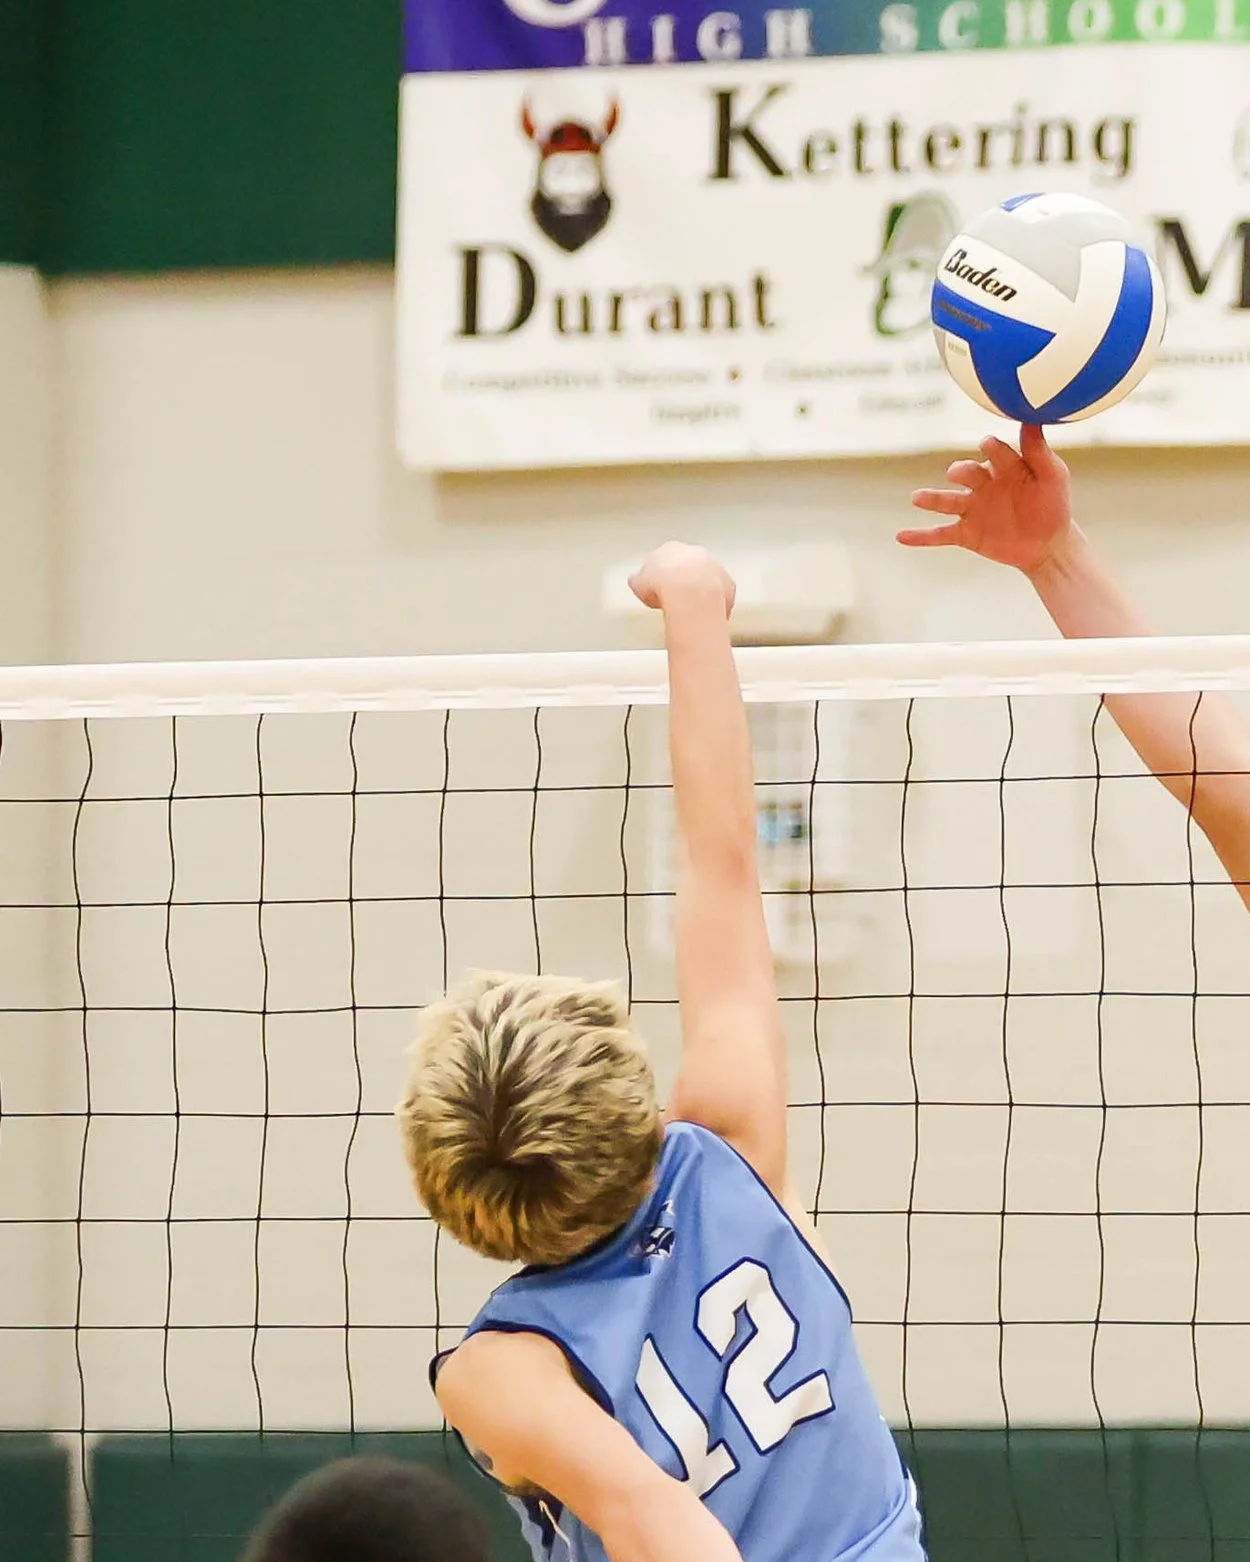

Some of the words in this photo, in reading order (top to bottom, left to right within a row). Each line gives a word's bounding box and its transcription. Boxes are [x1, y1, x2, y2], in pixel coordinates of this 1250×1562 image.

[581, 8, 813, 65] HIGH
[706, 83, 1137, 184] Kettering
[455, 244, 775, 337] Durant
[944, 248, 1018, 302] Baden
[634, 1256, 837, 1501] 12
